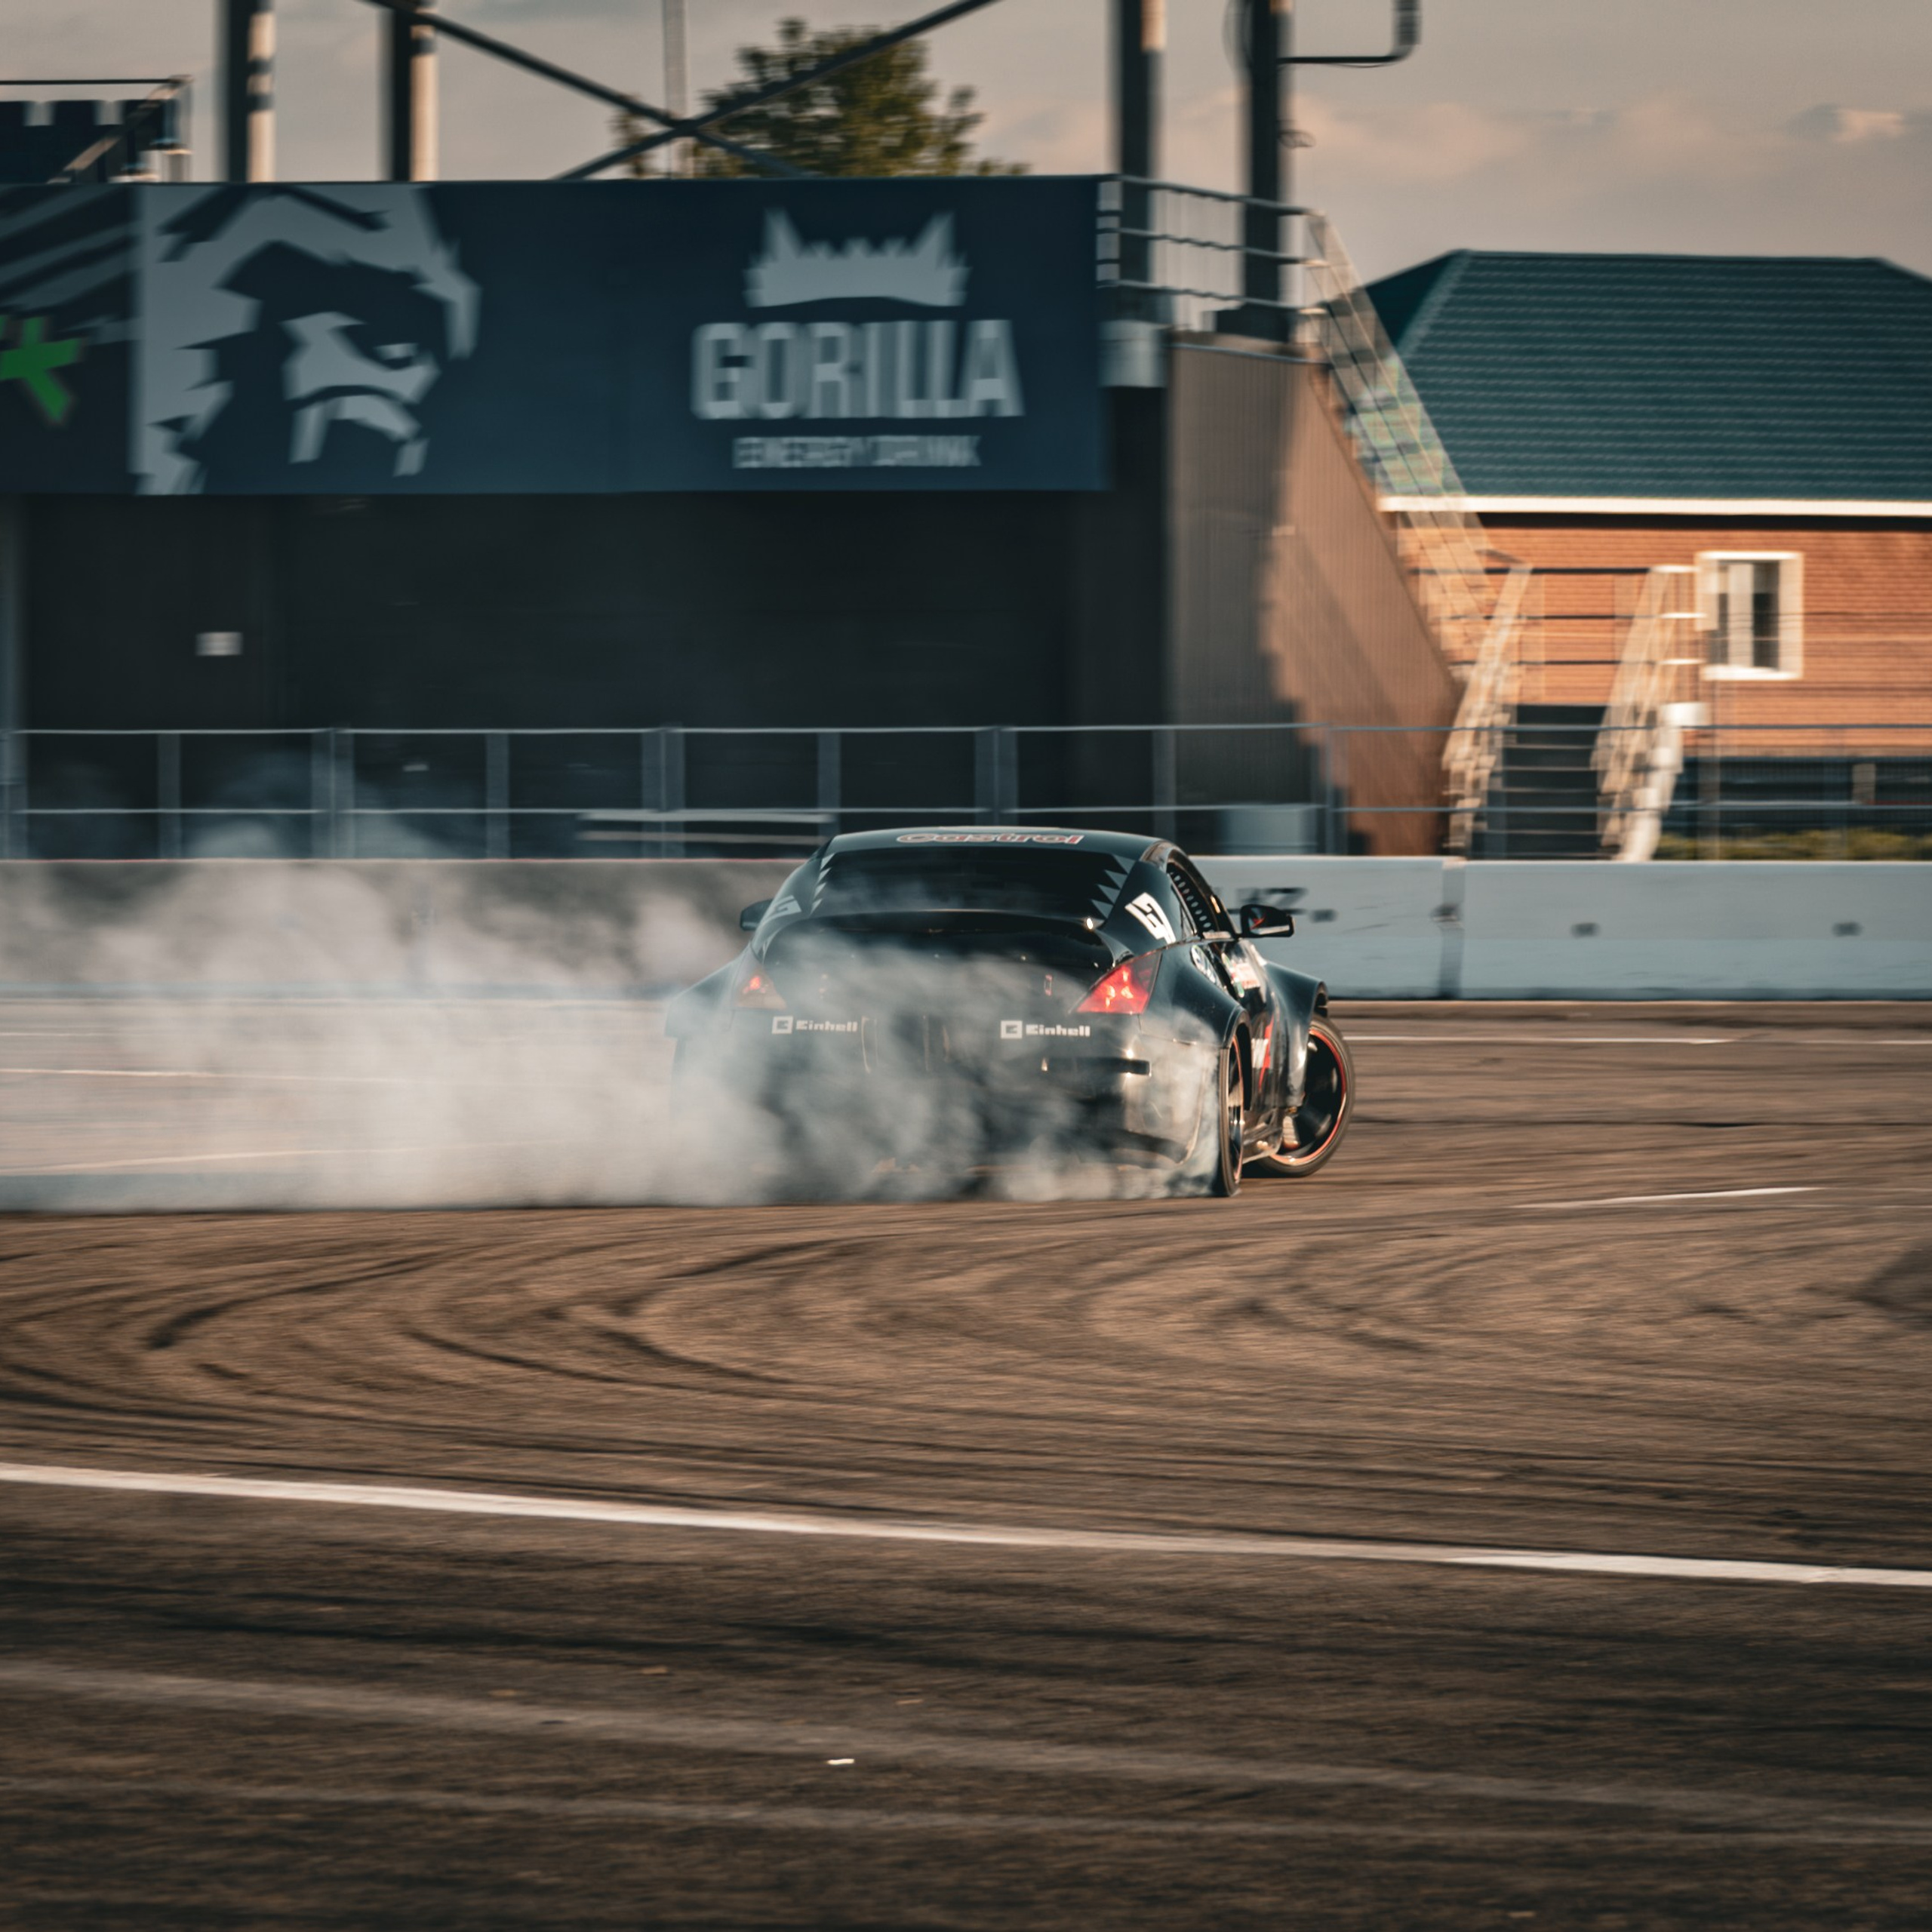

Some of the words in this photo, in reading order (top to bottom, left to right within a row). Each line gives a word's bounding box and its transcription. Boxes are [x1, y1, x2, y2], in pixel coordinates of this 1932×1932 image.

[691, 320, 1024, 418] GORILLA
[897, 833, 1084, 844] Castrol
[796, 1020, 858, 1032] Einhell
[1026, 1024, 1091, 1037] Einhell
